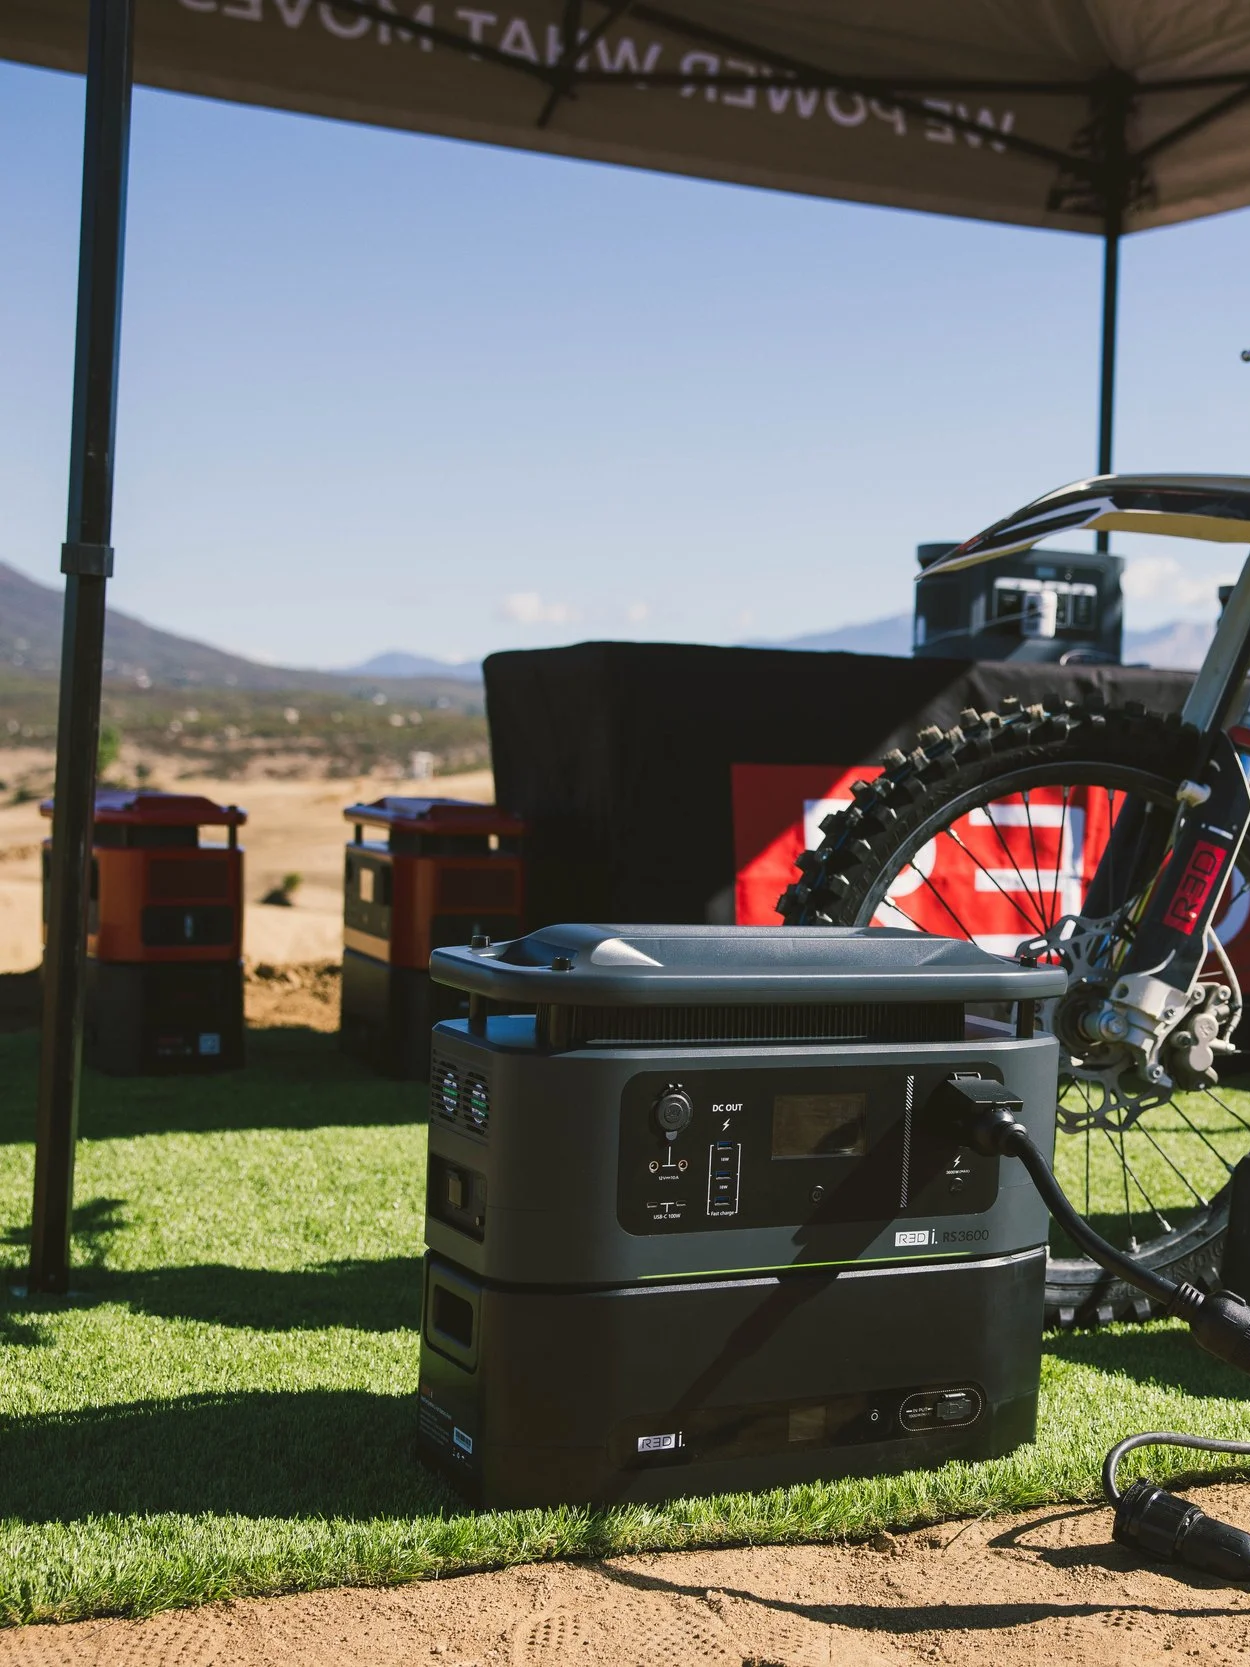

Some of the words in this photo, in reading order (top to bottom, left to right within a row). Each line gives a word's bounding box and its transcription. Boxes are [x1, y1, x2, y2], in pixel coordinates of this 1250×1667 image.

[712, 1104, 724, 1112] DC
[725, 1103, 743, 1112] OUT
[942, 1229, 990, 1243] RS3600
